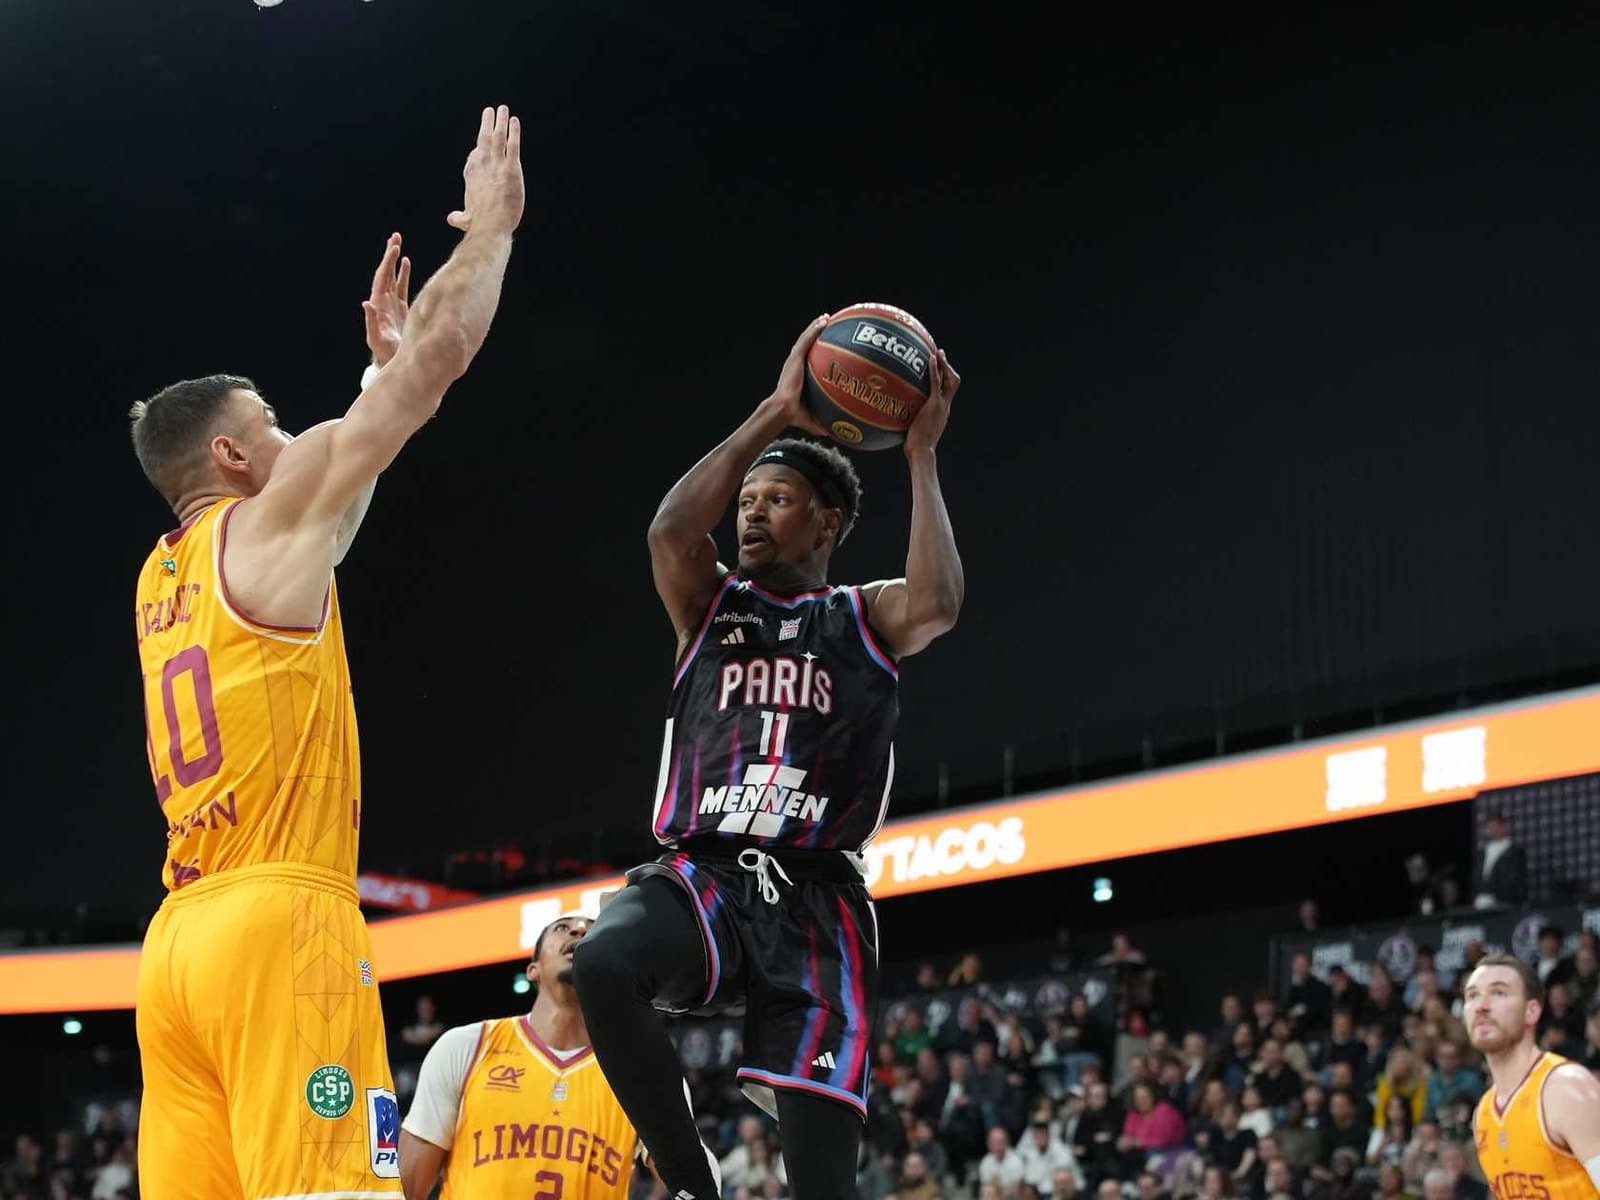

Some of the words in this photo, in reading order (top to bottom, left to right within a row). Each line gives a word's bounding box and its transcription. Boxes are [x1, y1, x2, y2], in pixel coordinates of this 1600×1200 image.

[856, 325, 925, 373] Betclic
[718, 655, 832, 715] PARIS
[758, 711, 789, 757] 11
[698, 784, 829, 822] MENNEN
[312, 1075, 350, 1102] CSP
[473, 1123, 622, 1187] LIMOGES
